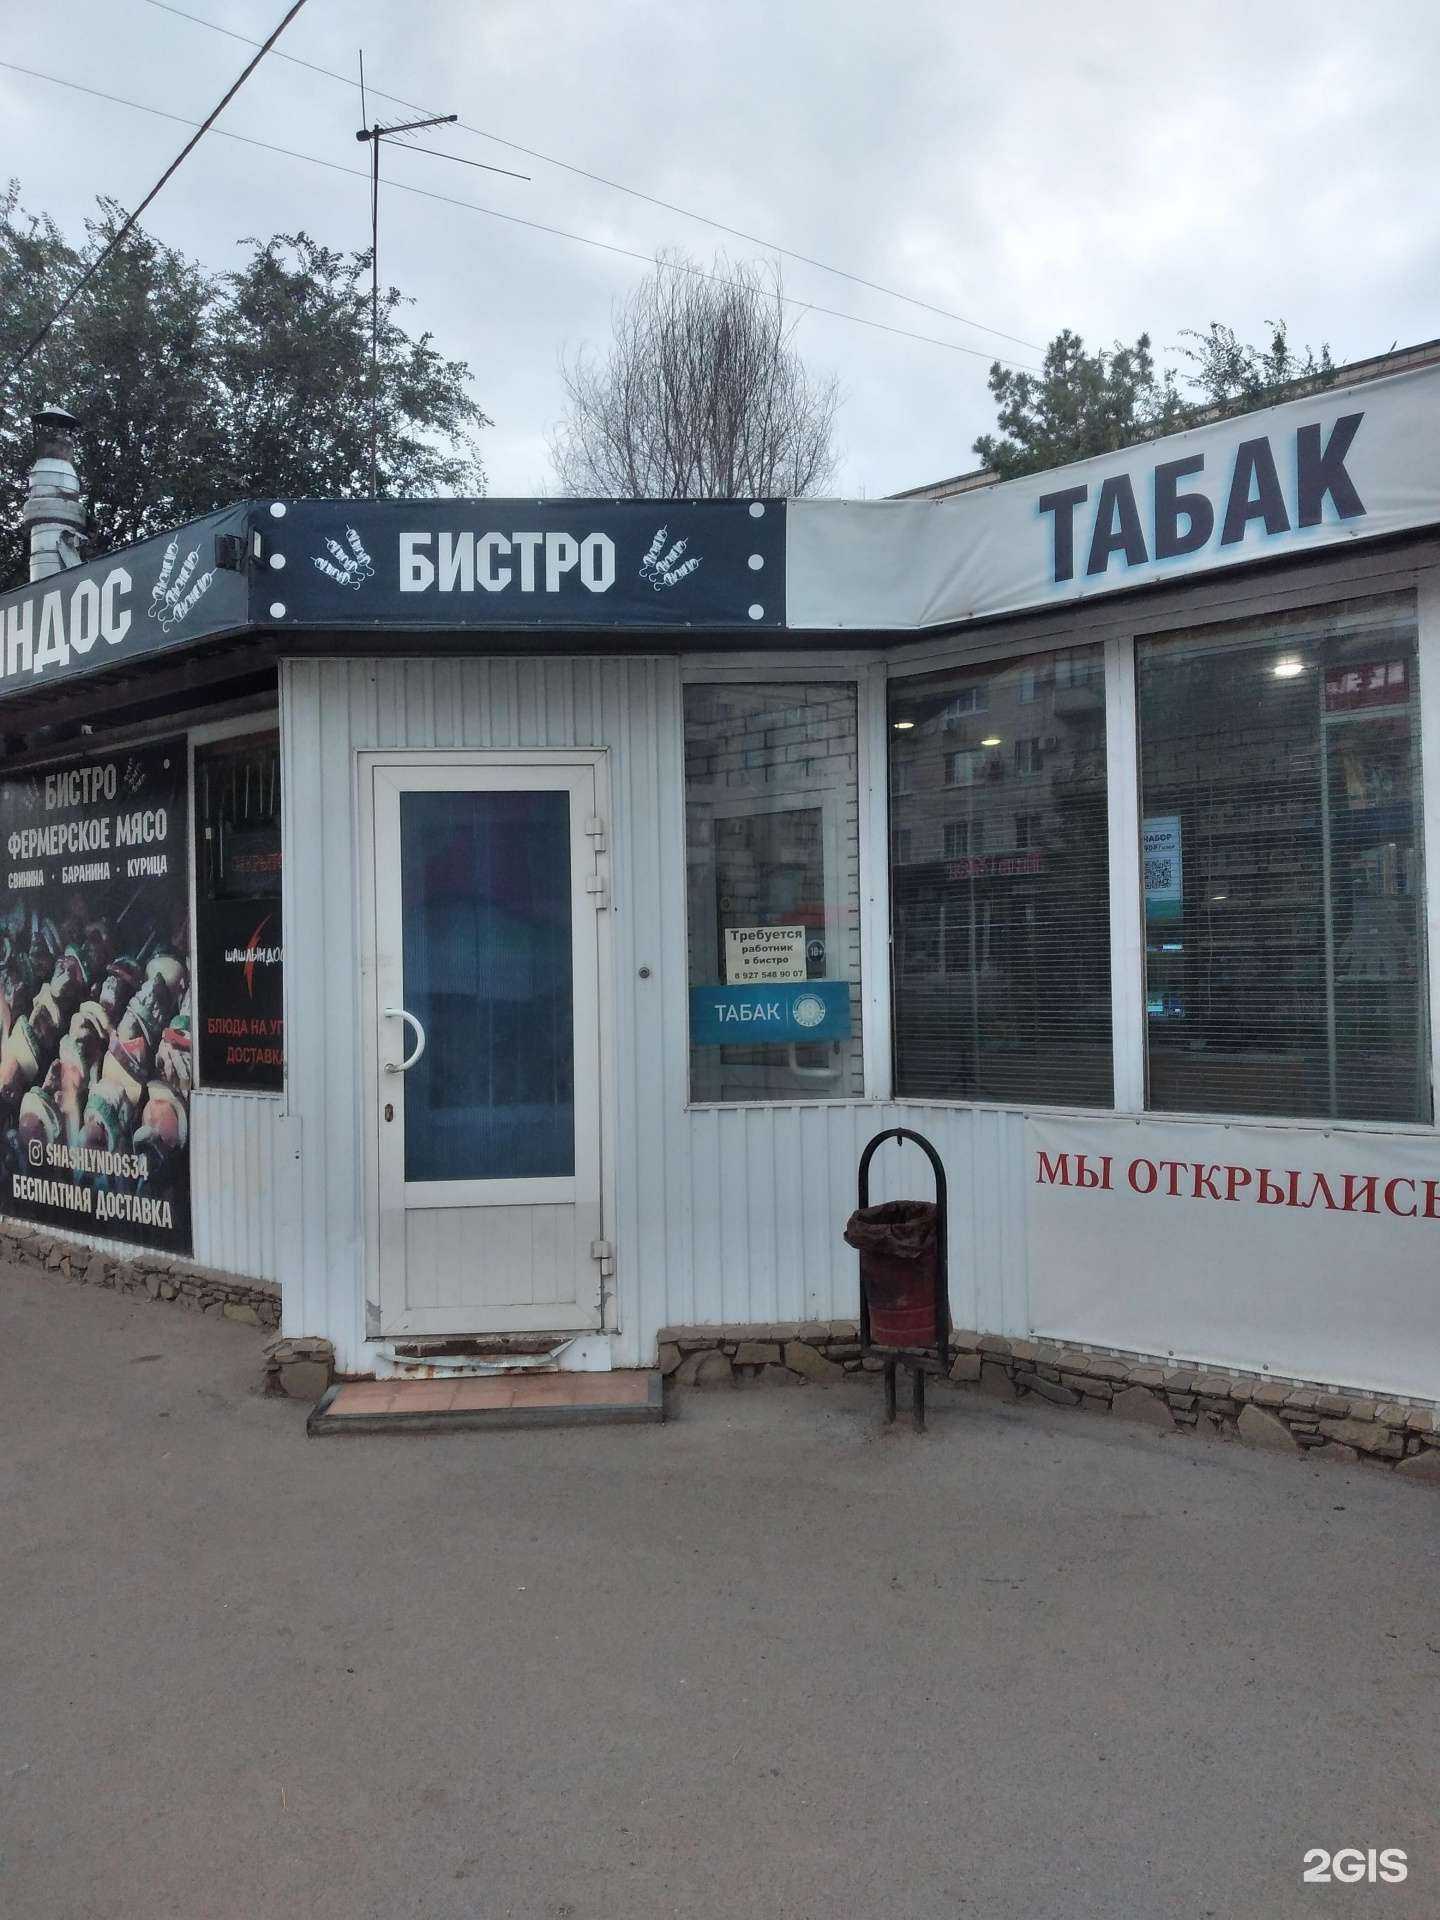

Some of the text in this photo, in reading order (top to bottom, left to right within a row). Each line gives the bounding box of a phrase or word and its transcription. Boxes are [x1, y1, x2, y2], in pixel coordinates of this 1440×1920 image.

[1039, 411, 1368, 583] ТАБАК
[399, 532, 616, 593] БИСТРО
[0, 567, 132, 679] НДОС
[45, 763, 117, 810] БИСТРО
[7, 808, 167, 860] ФЕРМЕРСКОЕ МЯСО
[8, 855, 168, 889] СВИНИНА БАРАНИНА КУРИЦА
[730, 929, 802, 943] Требуется
[742, 944, 793, 955] работник
[753, 957, 789, 966] бистро
[207, 1018, 248, 1037] БЛЮДА
[250, 1018, 267, 1035] НА
[714, 1003, 780, 1023] ТАБАК
[46, 1143, 149, 1181] SHASHLYNDOS34
[12, 1174, 173, 1229] БЕСПЛАТНАЯ ДОСТАВКА
[1036, 1151, 1440, 1219] МЫ ОТКРЫЛИСЬ
